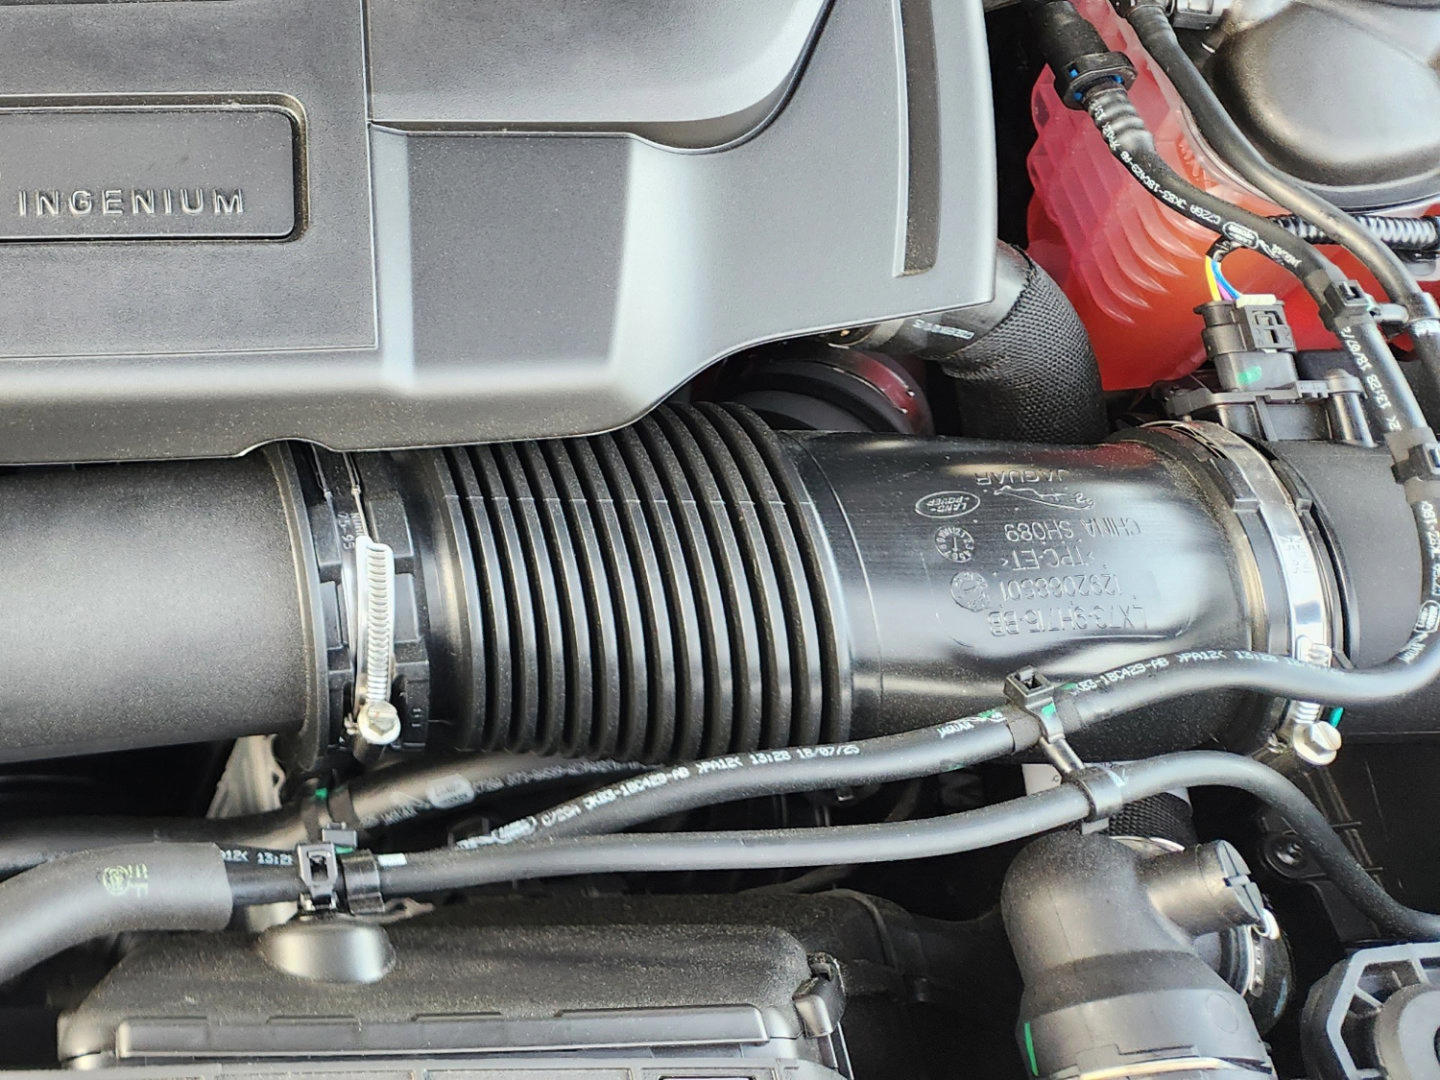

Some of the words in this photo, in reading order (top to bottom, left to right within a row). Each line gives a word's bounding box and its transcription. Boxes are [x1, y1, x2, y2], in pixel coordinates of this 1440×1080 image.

[18, 188, 245, 217] INGENIUM
[1338, 325, 1372, 371] 18/07/2
[1365, 372, 1392, 410] 13:28
[1004, 520, 1074, 543] SH089
[1081, 517, 1143, 538] CHINA
